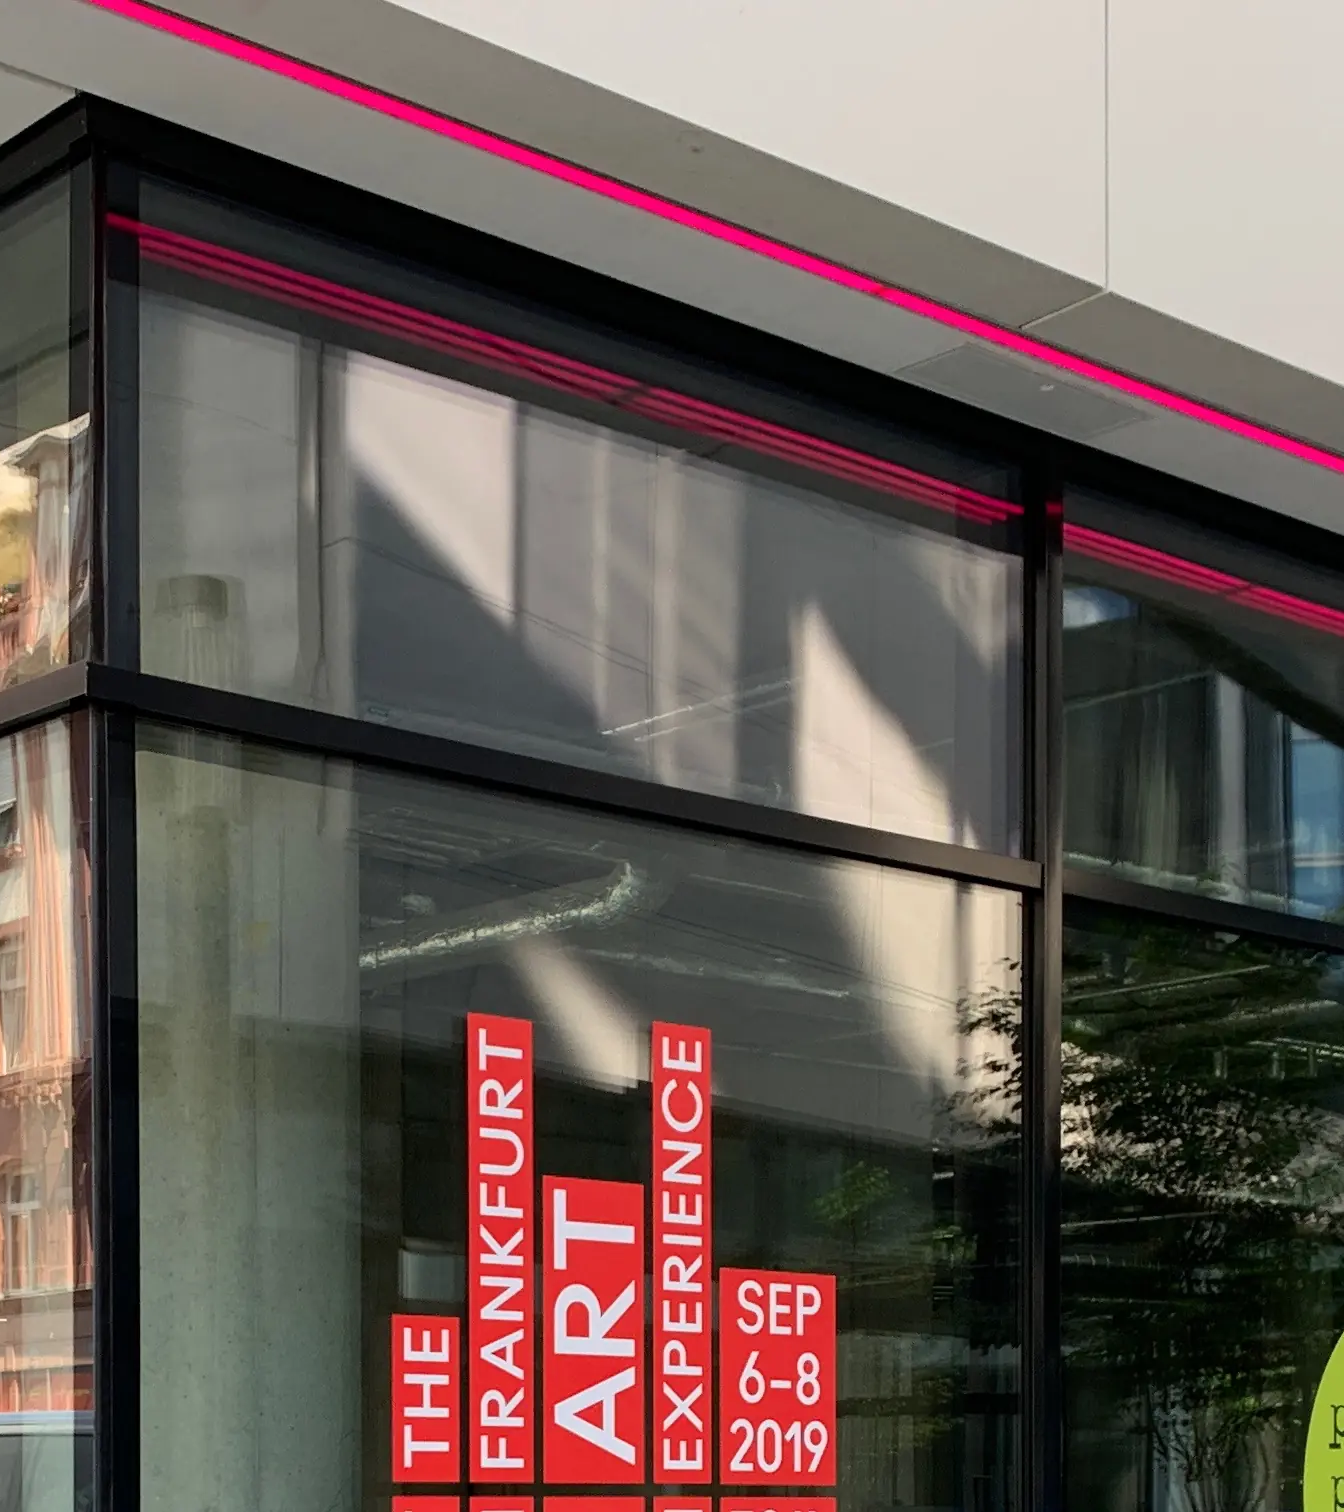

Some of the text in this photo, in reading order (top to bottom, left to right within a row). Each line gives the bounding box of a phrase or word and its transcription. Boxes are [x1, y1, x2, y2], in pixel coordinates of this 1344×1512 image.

[403, 1027, 704, 1471] THE FRANKFURT ART EXPERIENCE
[736, 1280, 822, 1336] SEP
[738, 1350, 821, 1406] 6-8
[729, 1418, 829, 1473] 2019
